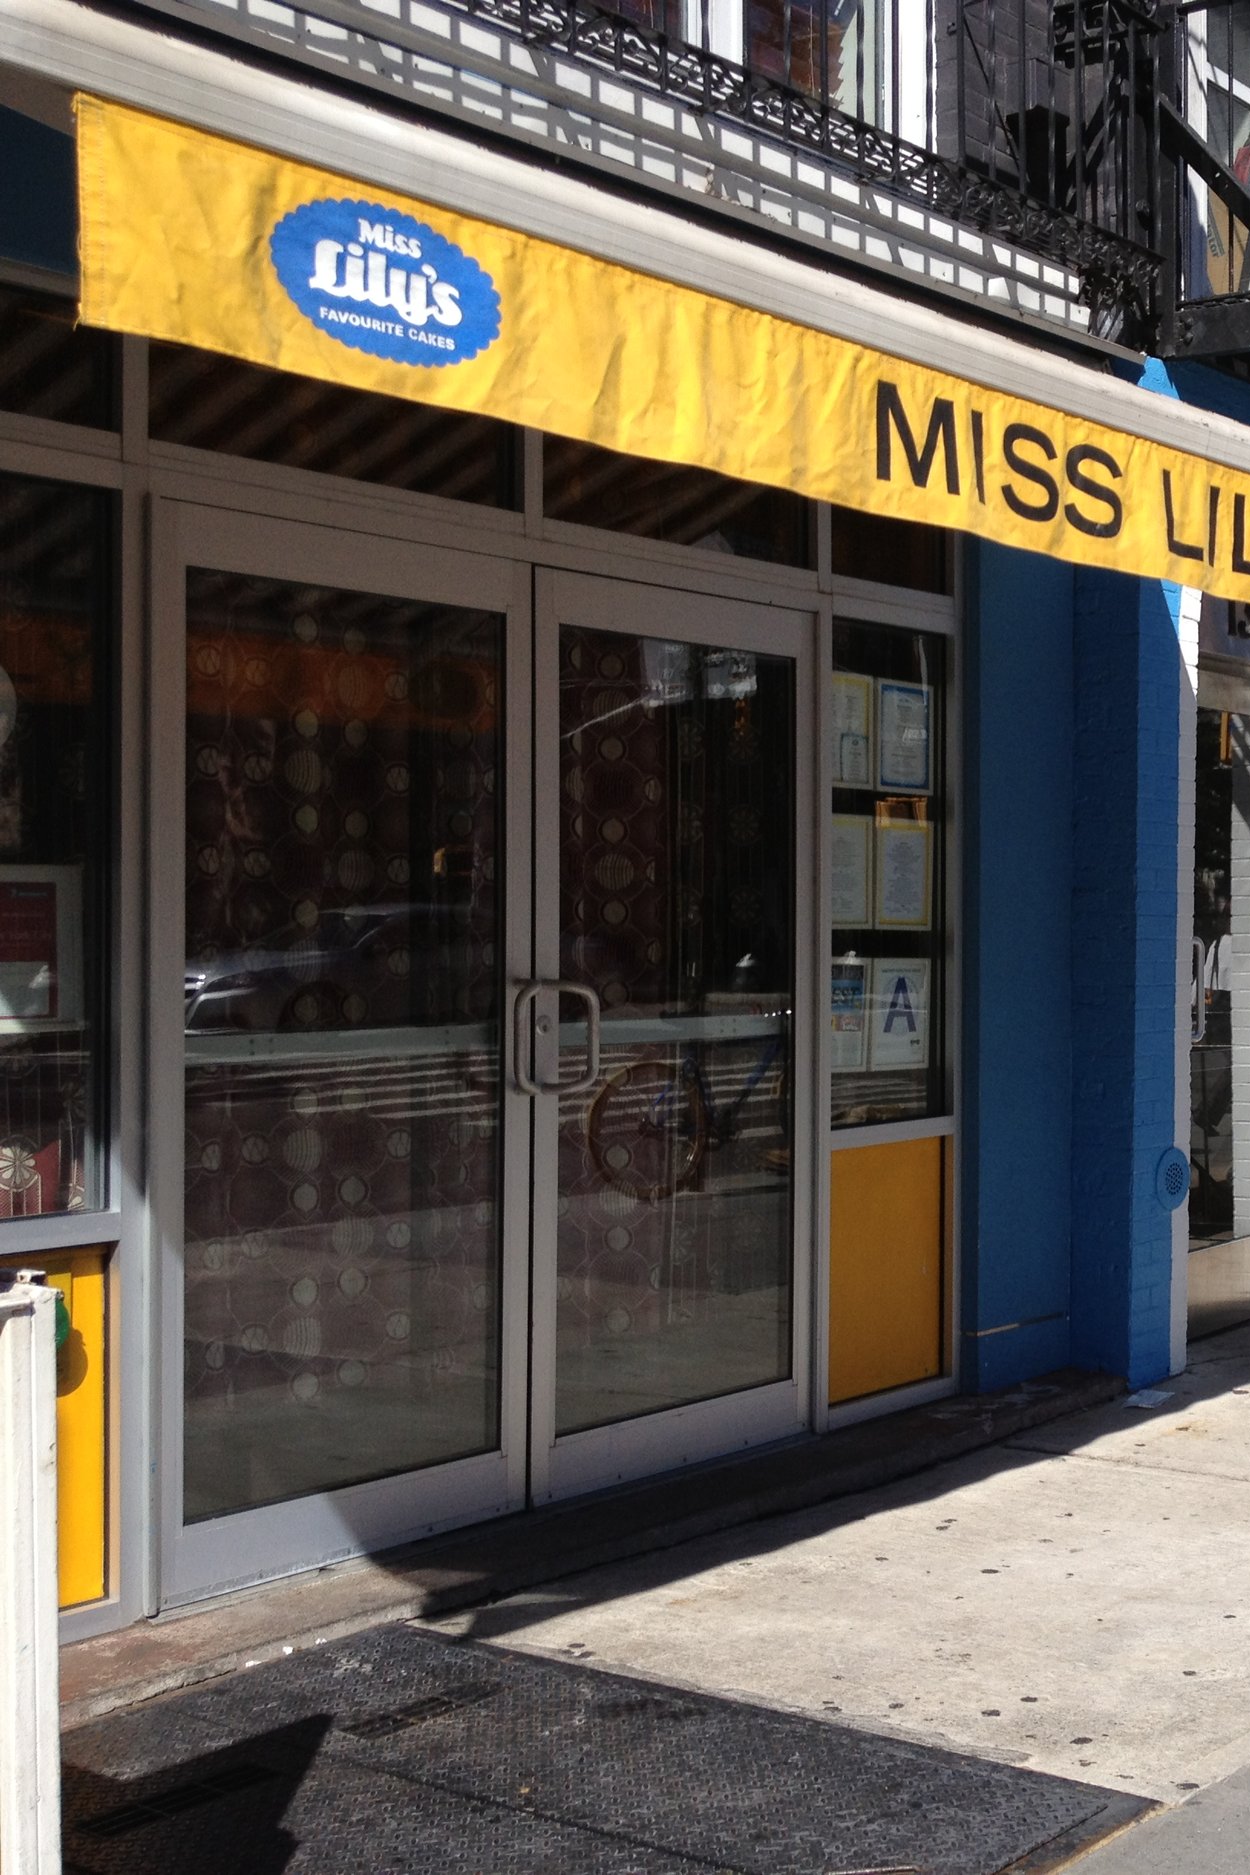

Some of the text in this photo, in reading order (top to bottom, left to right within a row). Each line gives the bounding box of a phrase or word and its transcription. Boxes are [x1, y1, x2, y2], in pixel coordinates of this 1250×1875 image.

[358, 217, 422, 259] Miss
[308, 239, 463, 327] Lily's
[319, 306, 456, 351] FAVOURITE CAKES
[876, 379, 1123, 539] MISS
[883, 976, 917, 1033] A
